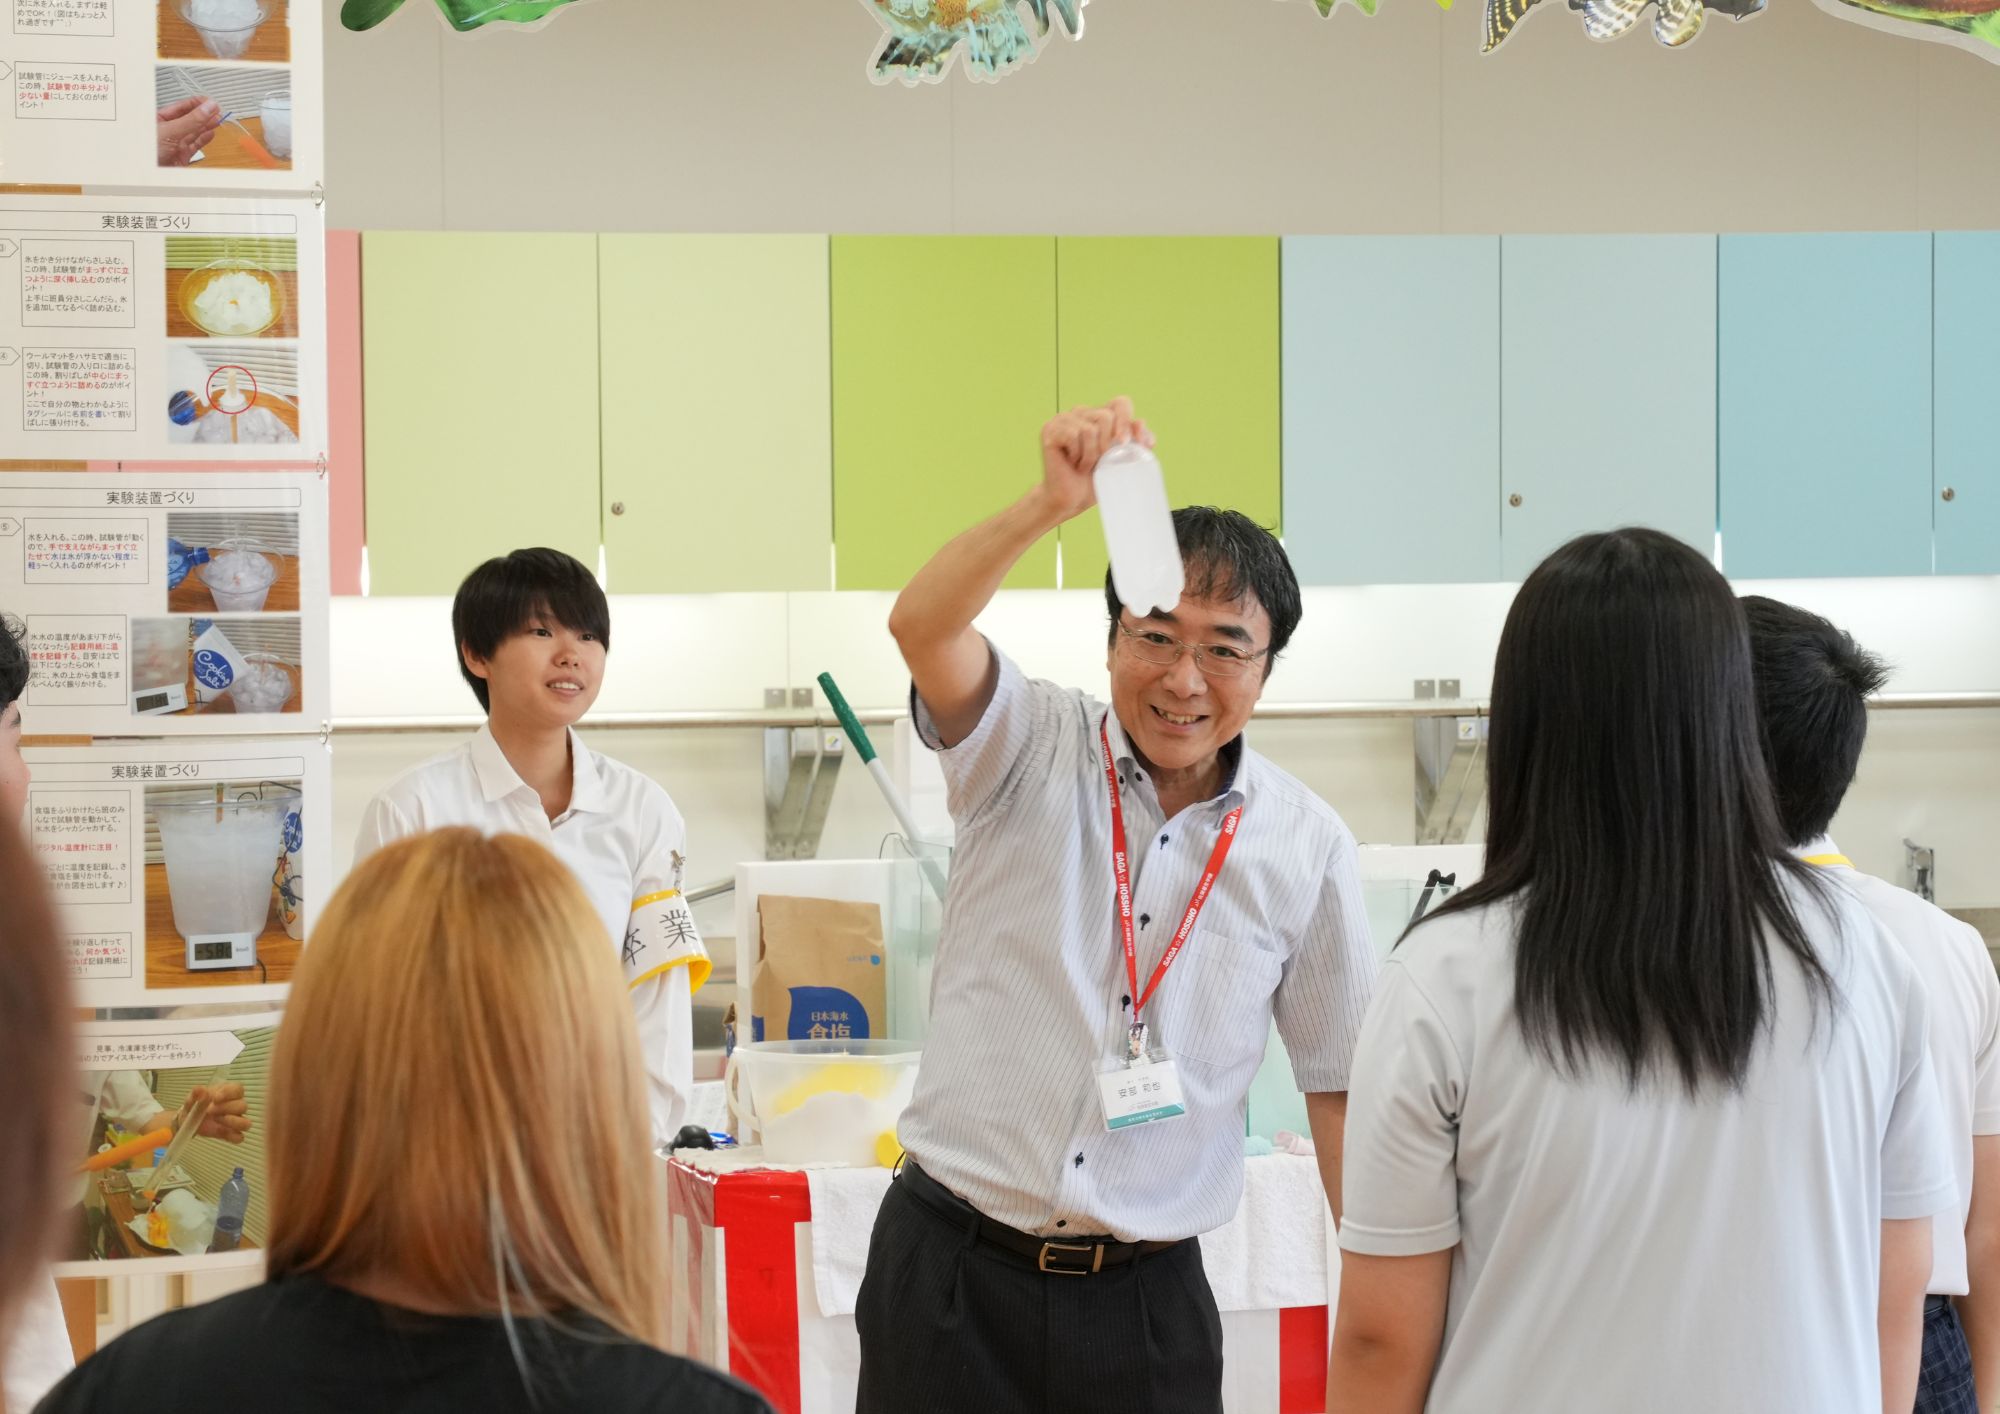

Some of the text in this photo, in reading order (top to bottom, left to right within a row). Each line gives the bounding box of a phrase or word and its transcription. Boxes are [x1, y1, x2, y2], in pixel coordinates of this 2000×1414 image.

[102, 215, 190, 229] 実験装置づくり
[107, 491, 194, 504] 実験装置づくり
[111, 764, 200, 779] 実験装置づくり
[1224, 815, 1238, 835] SAGA
[1115, 851, 1127, 874] SAGA
[1119, 883, 1131, 917] HOSSHO
[1162, 946, 1179, 968] SAGA
[1177, 907, 1198, 940] HOSSHO
[811, 1011, 849, 1021] 日本海水
